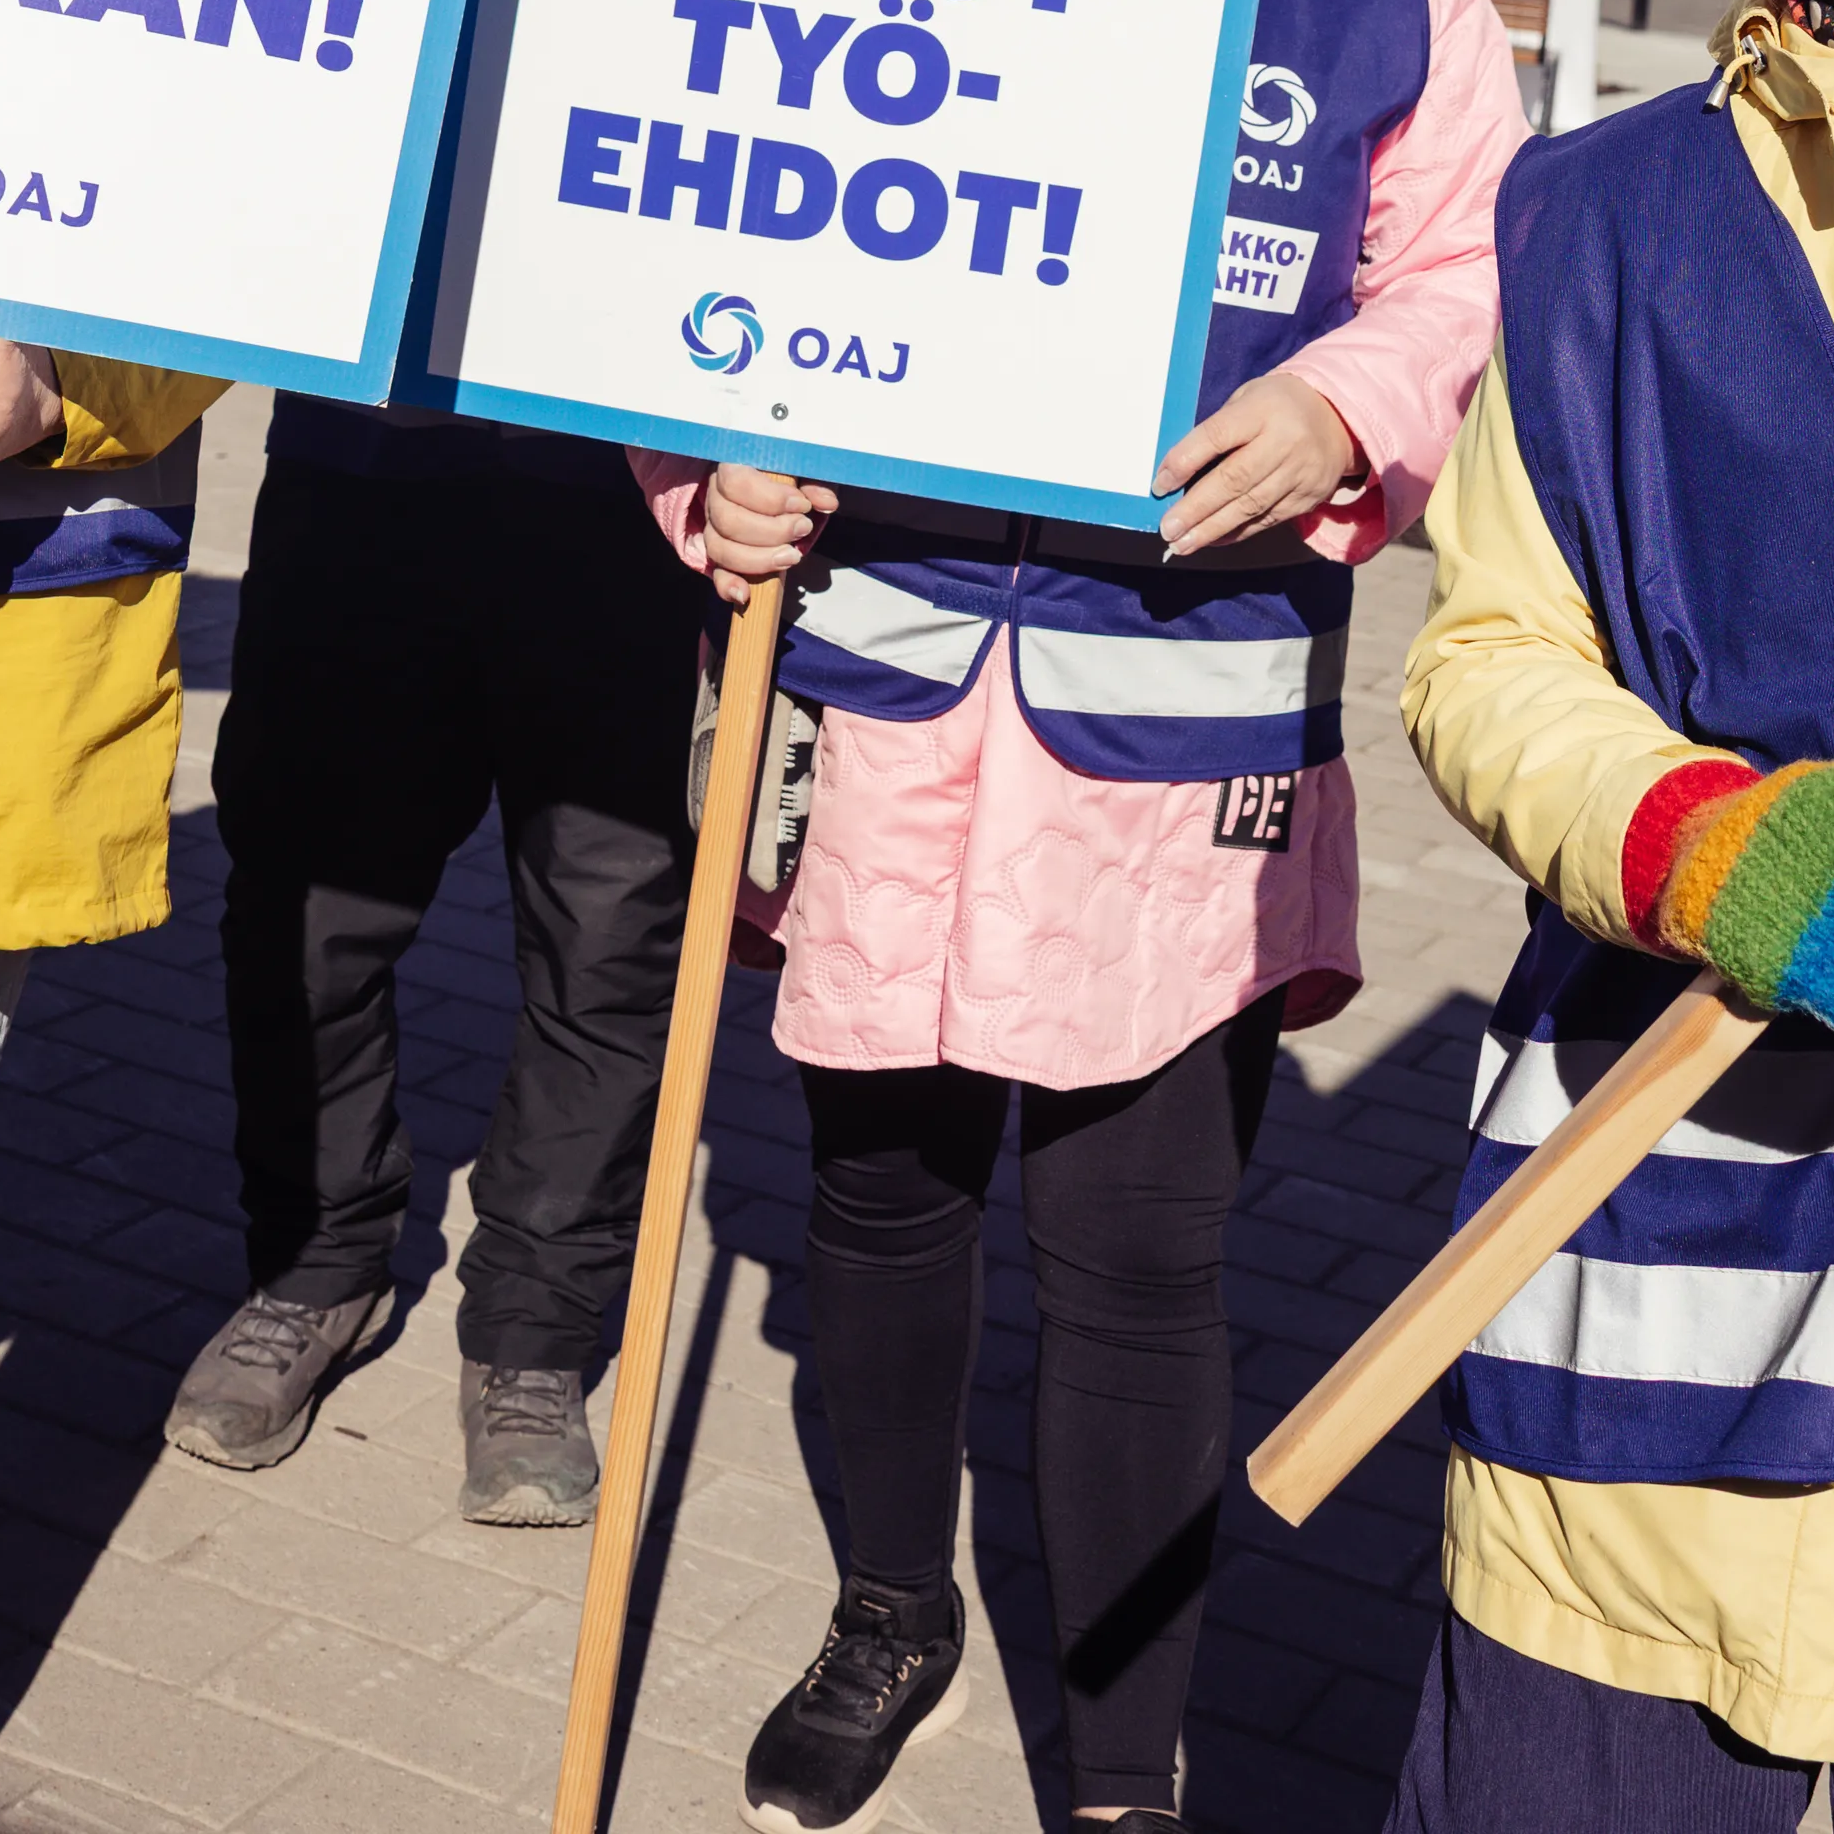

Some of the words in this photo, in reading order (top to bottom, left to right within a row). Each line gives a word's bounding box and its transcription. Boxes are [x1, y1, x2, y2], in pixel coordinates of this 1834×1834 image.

[558, 106, 1084, 286] EHDOT!
[1233, 155, 1304, 192] OAJ
[1220, 231, 1305, 266] KKO-
[787, 327, 910, 383] OAJ
[1221, 774, 1292, 840] PE
